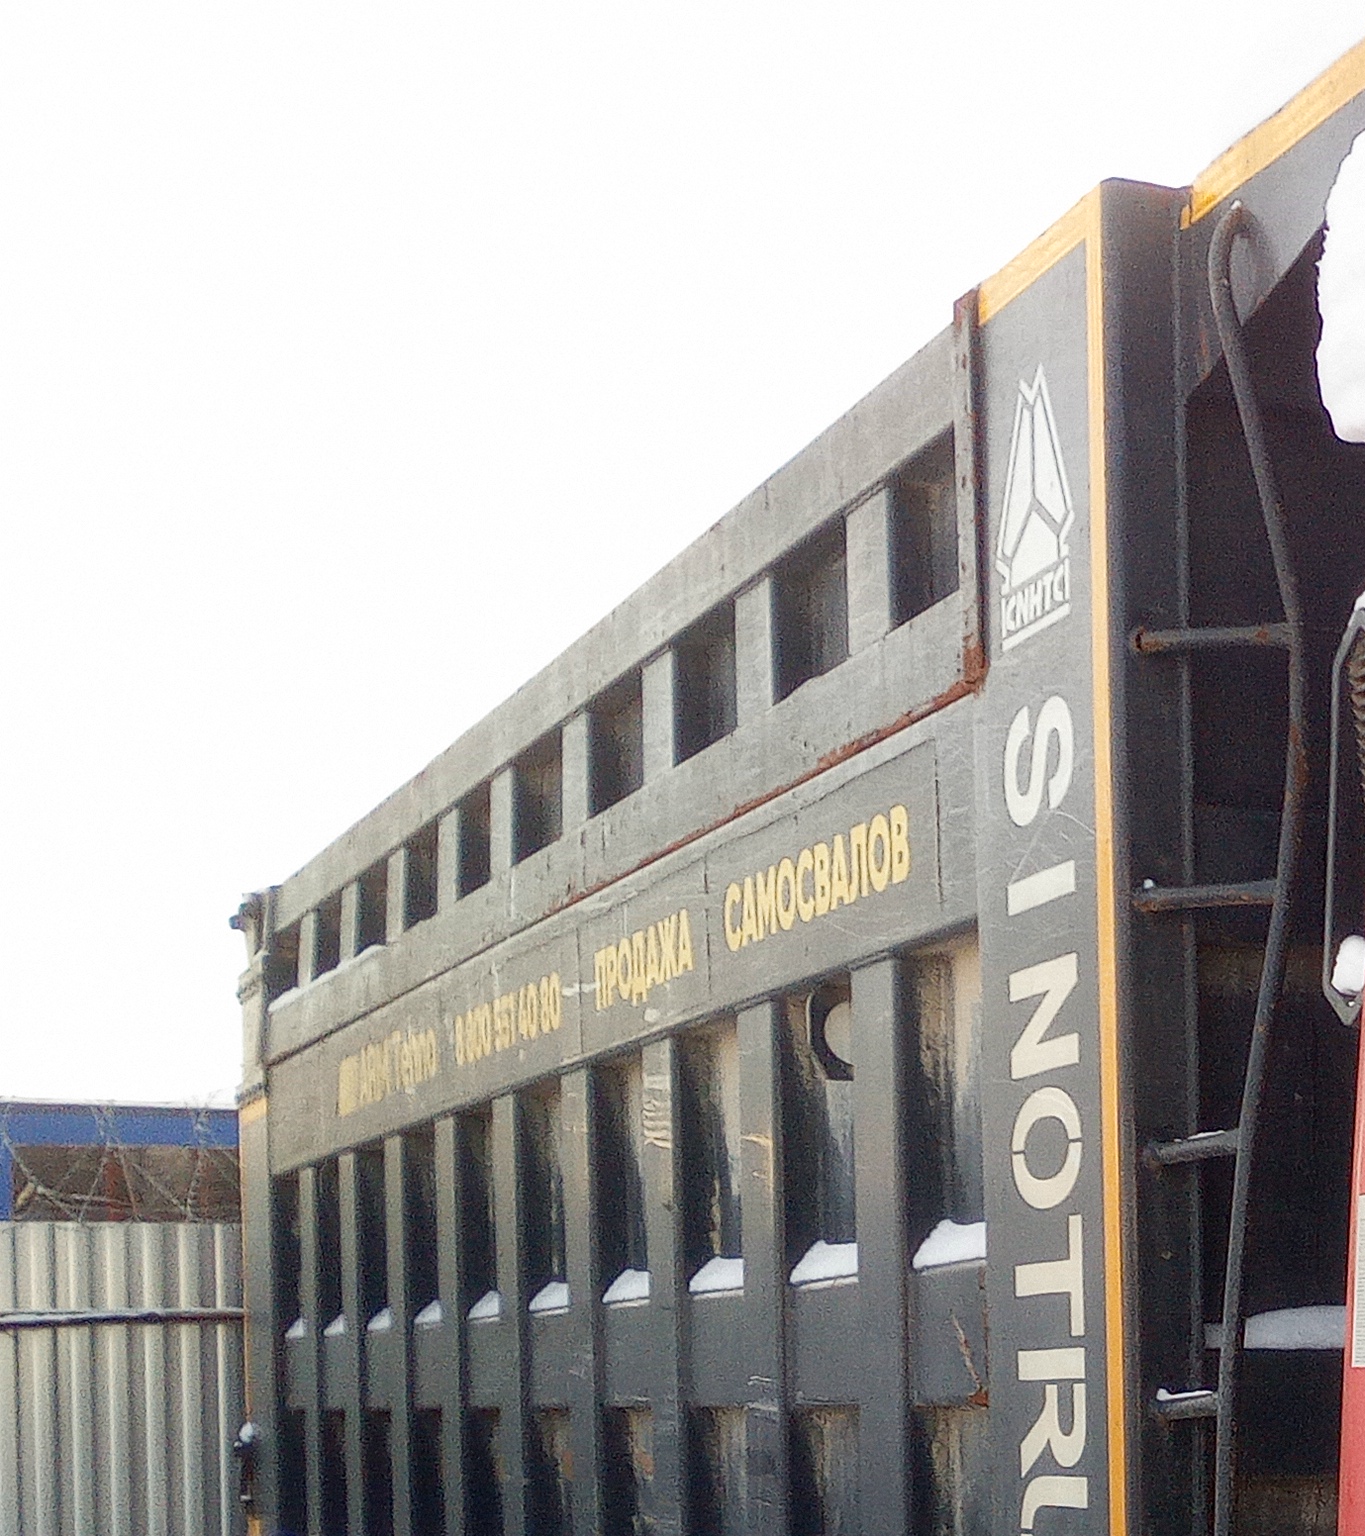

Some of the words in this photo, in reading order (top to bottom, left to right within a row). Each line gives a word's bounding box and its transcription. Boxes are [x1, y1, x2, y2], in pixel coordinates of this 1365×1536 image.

[540, 971, 560, 1034] 80
[594, 909, 693, 1011] ПРОДАЖА
[724, 805, 911, 952] САМОСВАЛОВ
